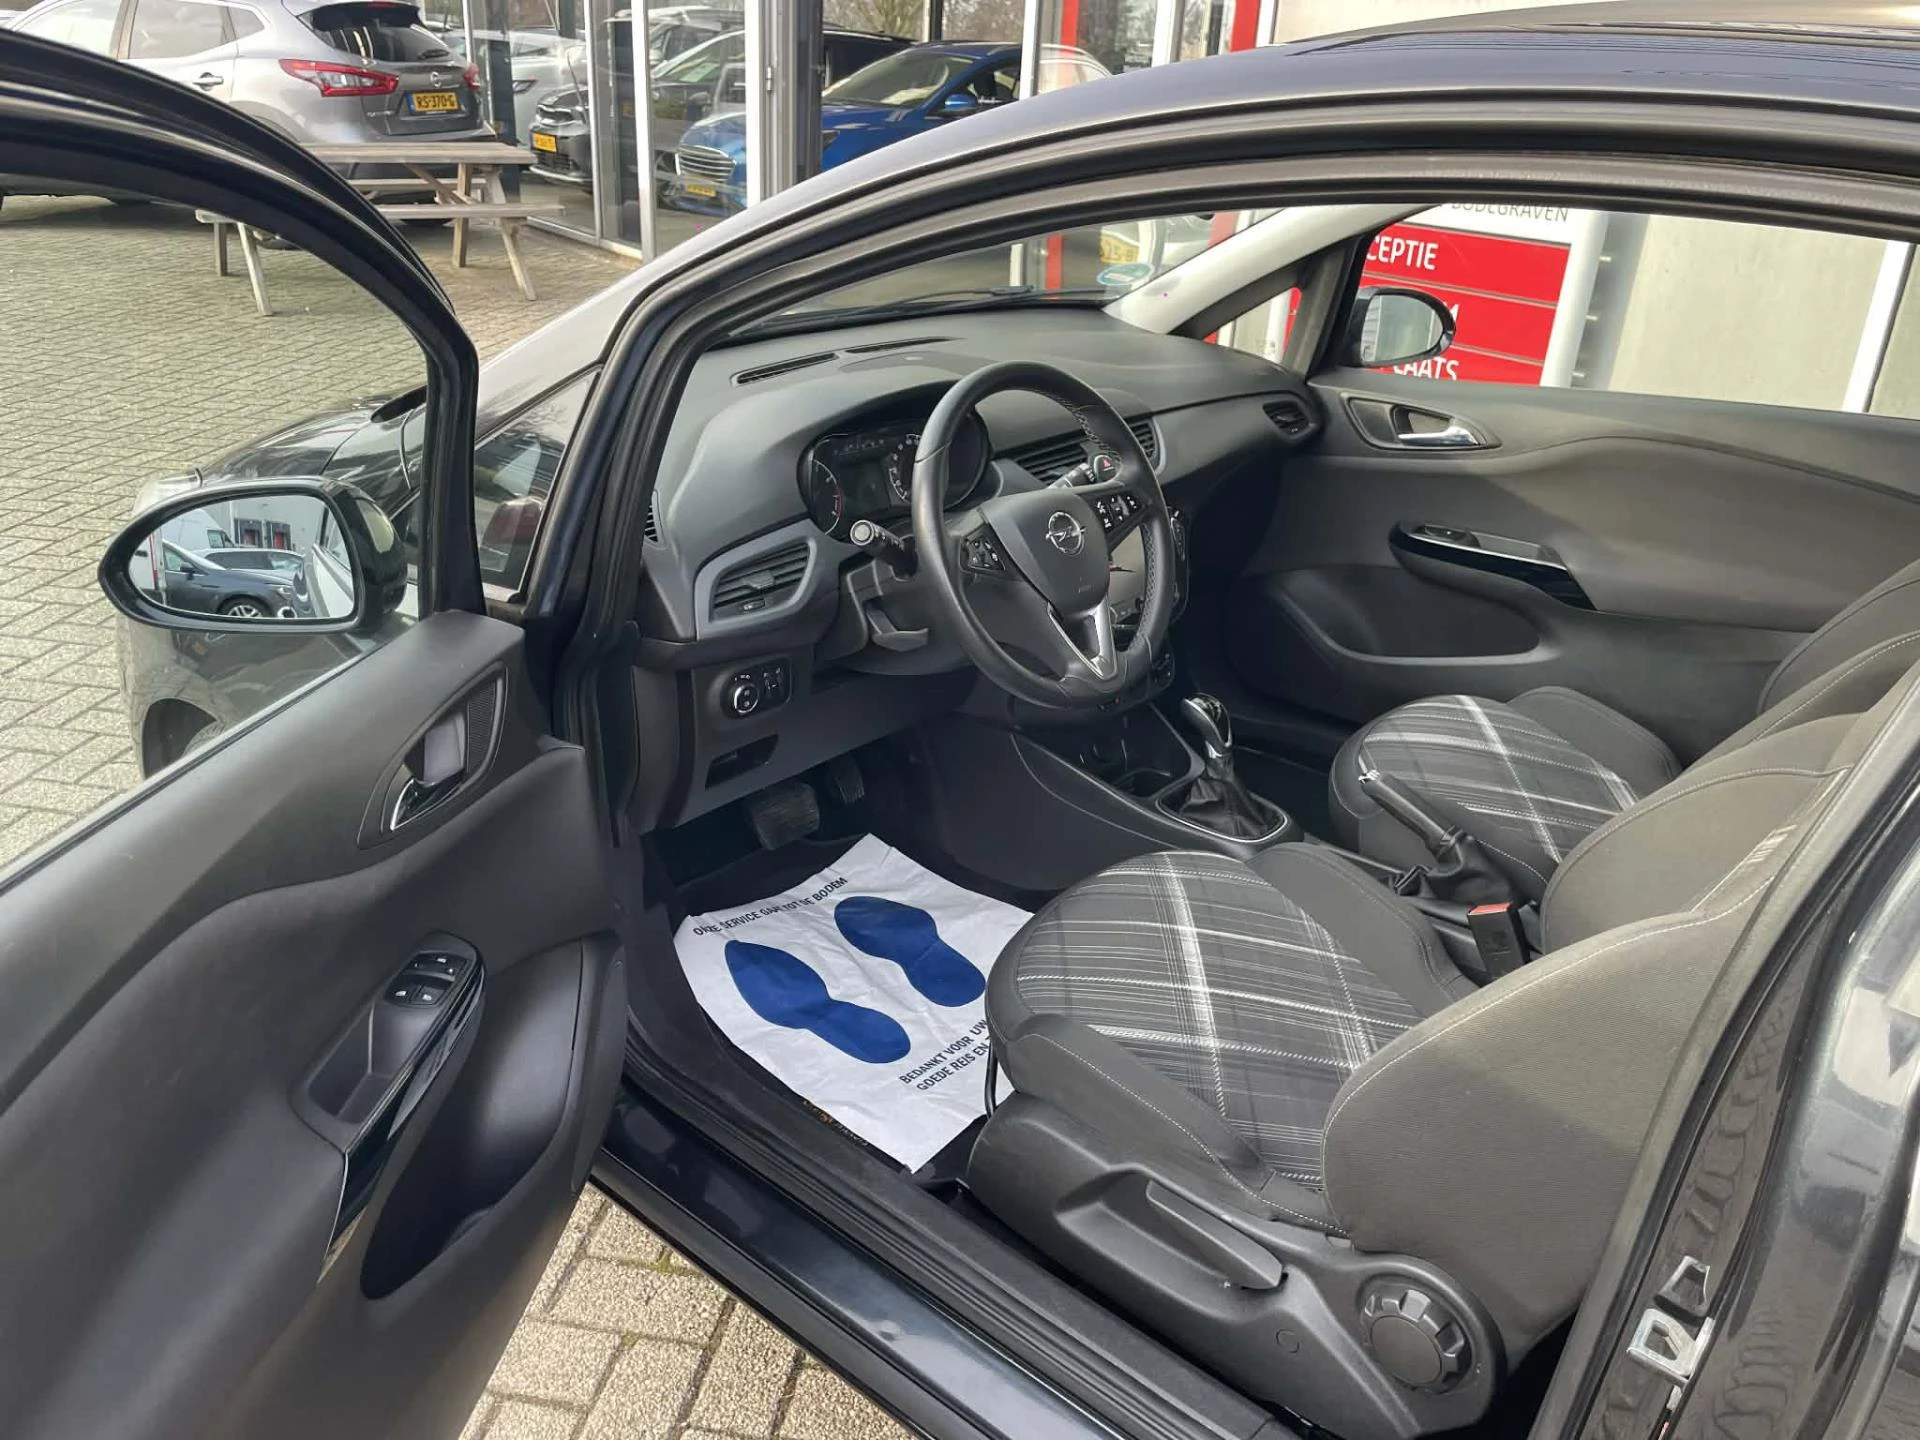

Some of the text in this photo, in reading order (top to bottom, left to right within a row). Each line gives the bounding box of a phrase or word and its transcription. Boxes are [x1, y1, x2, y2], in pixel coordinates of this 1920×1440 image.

[720, 911, 762, 930] SERVICE
[812, 876, 848, 902] BODEM
[899, 1019, 988, 1084] BEDANKT VOOR UW
[916, 1042, 989, 1091] GOEDE REIS EN
